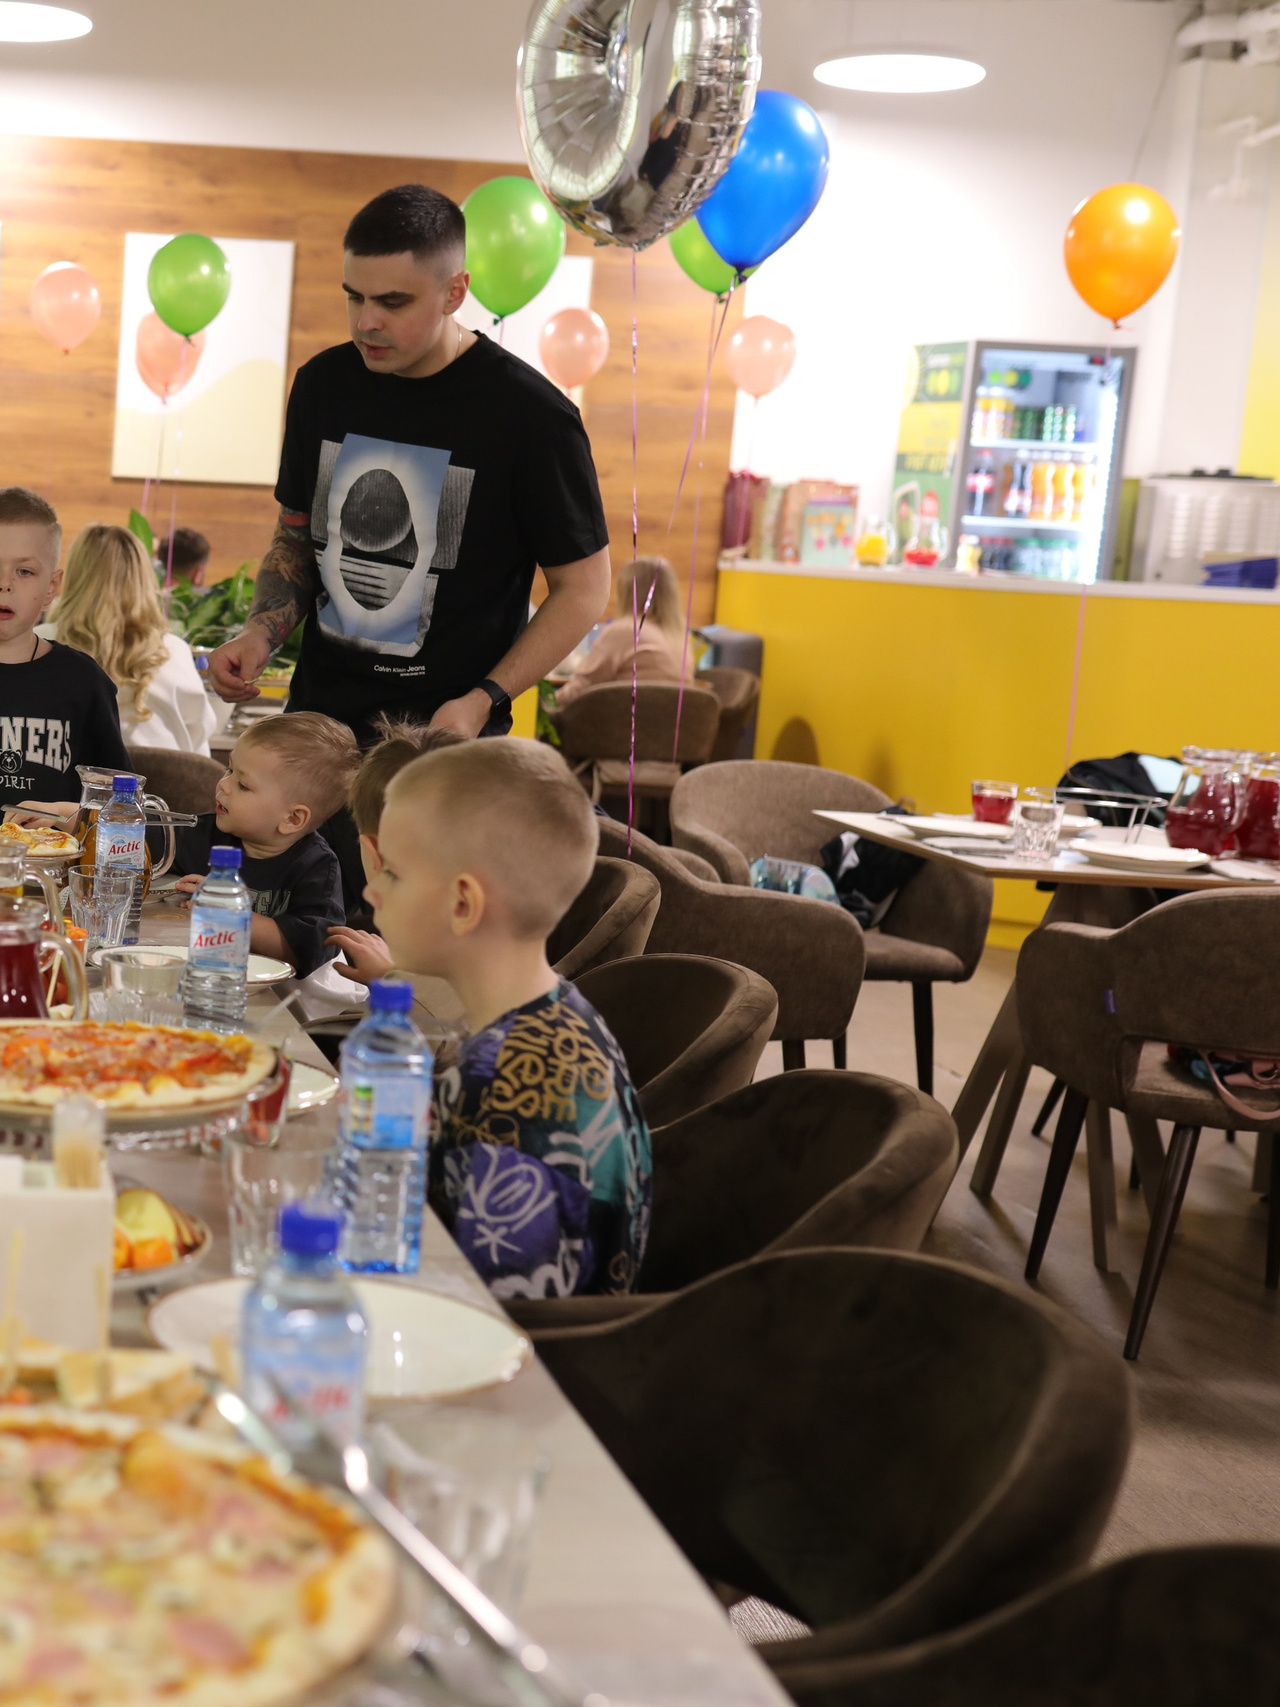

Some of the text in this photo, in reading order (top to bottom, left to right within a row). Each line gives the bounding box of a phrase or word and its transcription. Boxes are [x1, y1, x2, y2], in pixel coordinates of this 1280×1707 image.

[373, 664, 391, 672] Calvin
[108, 840, 142, 856] Arctic
[193, 930, 237, 949] Arctic
